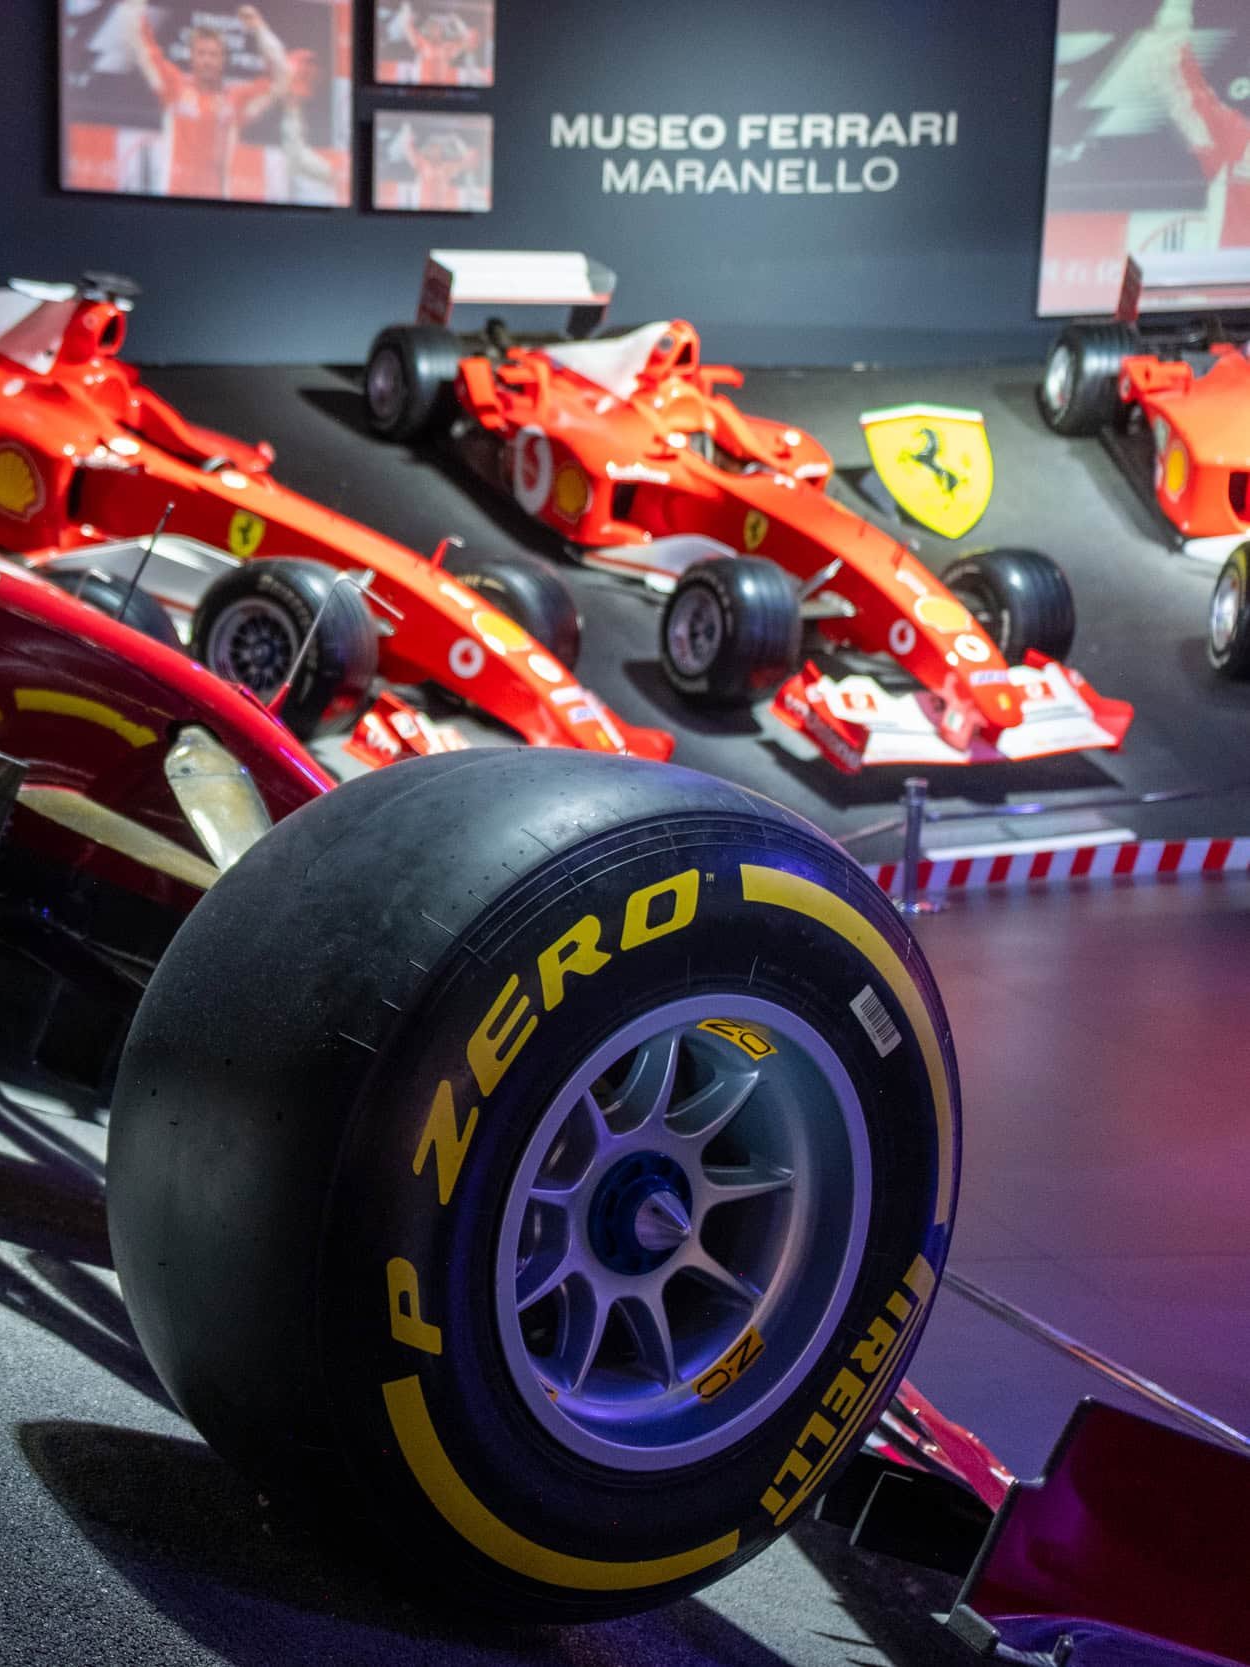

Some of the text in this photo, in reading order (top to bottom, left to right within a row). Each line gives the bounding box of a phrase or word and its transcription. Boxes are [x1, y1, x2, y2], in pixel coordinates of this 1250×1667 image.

[550, 111, 959, 151] MUSEO FERRARI
[601, 156, 900, 195] MARANELLO
[386, 868, 700, 1356] P ZERO
